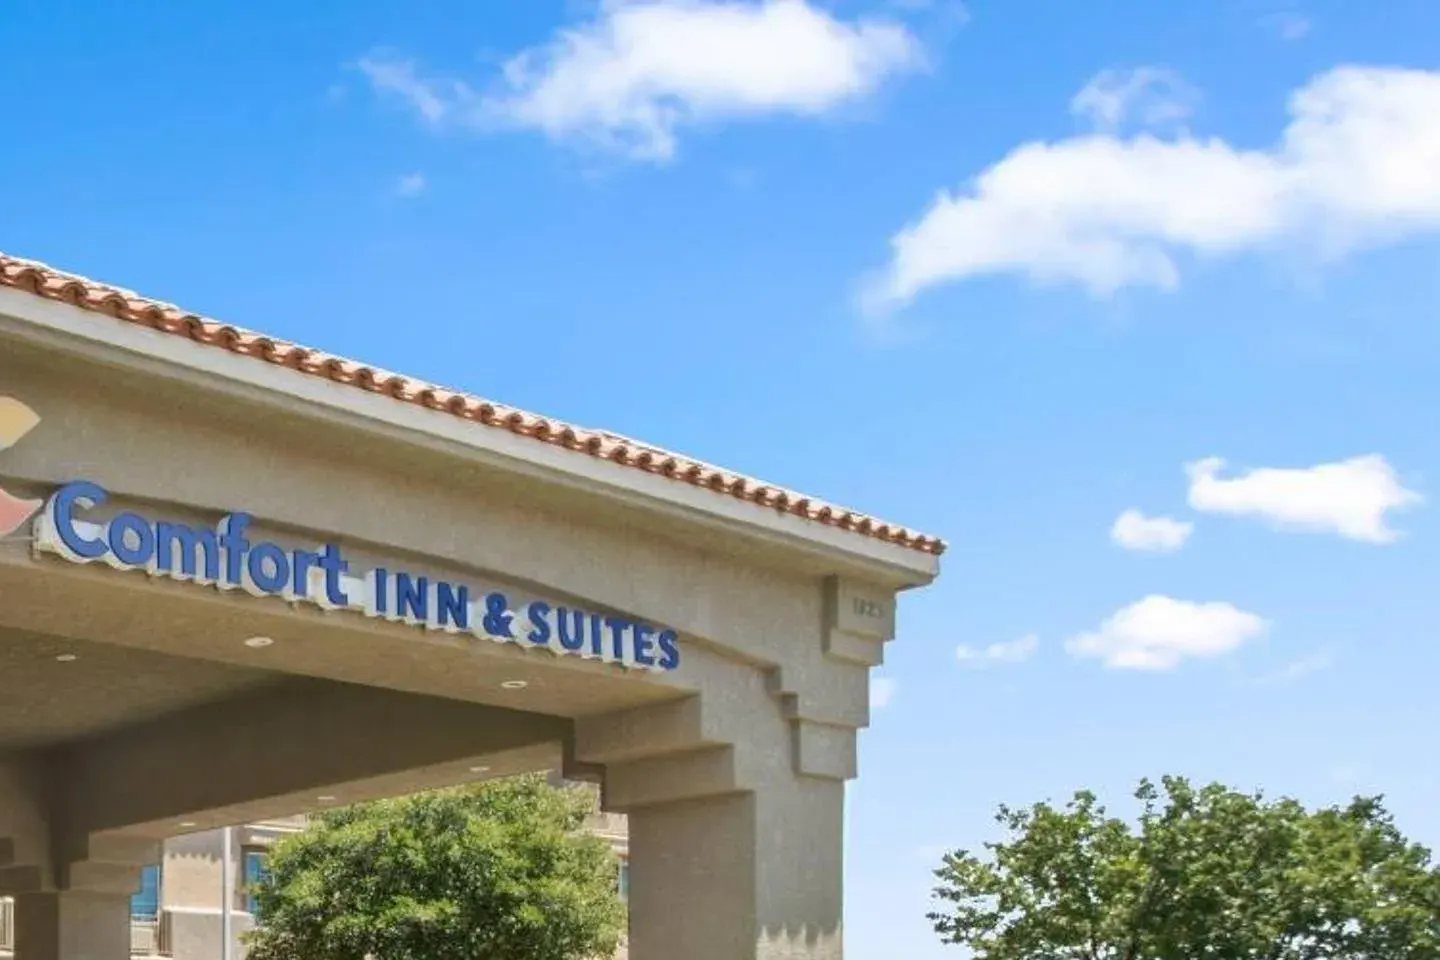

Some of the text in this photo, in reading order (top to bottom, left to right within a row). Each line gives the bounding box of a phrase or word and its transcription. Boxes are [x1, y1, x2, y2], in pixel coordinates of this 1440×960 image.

[52, 480, 680, 670] Comfort INN & SUITES
